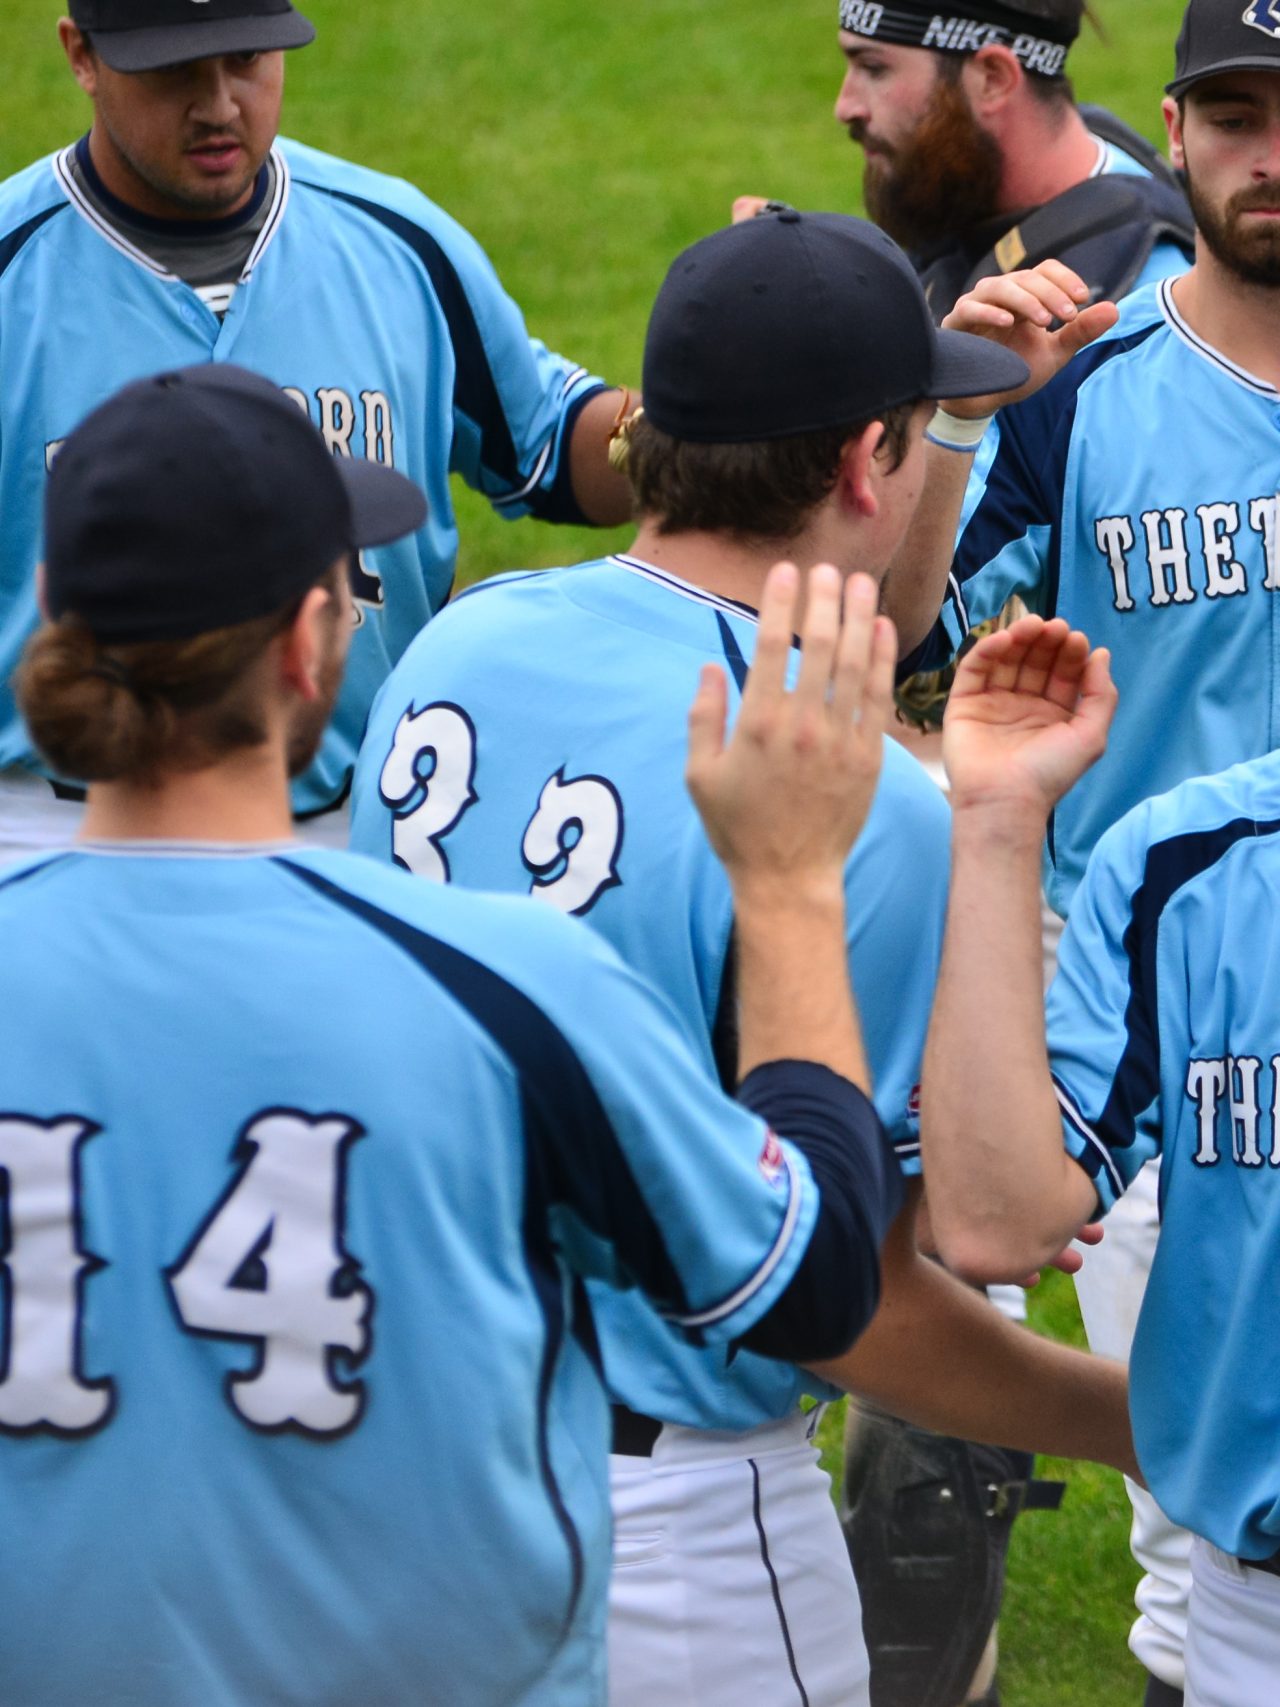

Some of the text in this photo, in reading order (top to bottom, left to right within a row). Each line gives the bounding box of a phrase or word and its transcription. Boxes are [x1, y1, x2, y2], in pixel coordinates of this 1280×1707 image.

[921, 15, 1066, 76] NIKE PRO
[0, 1106, 375, 1443] 14
